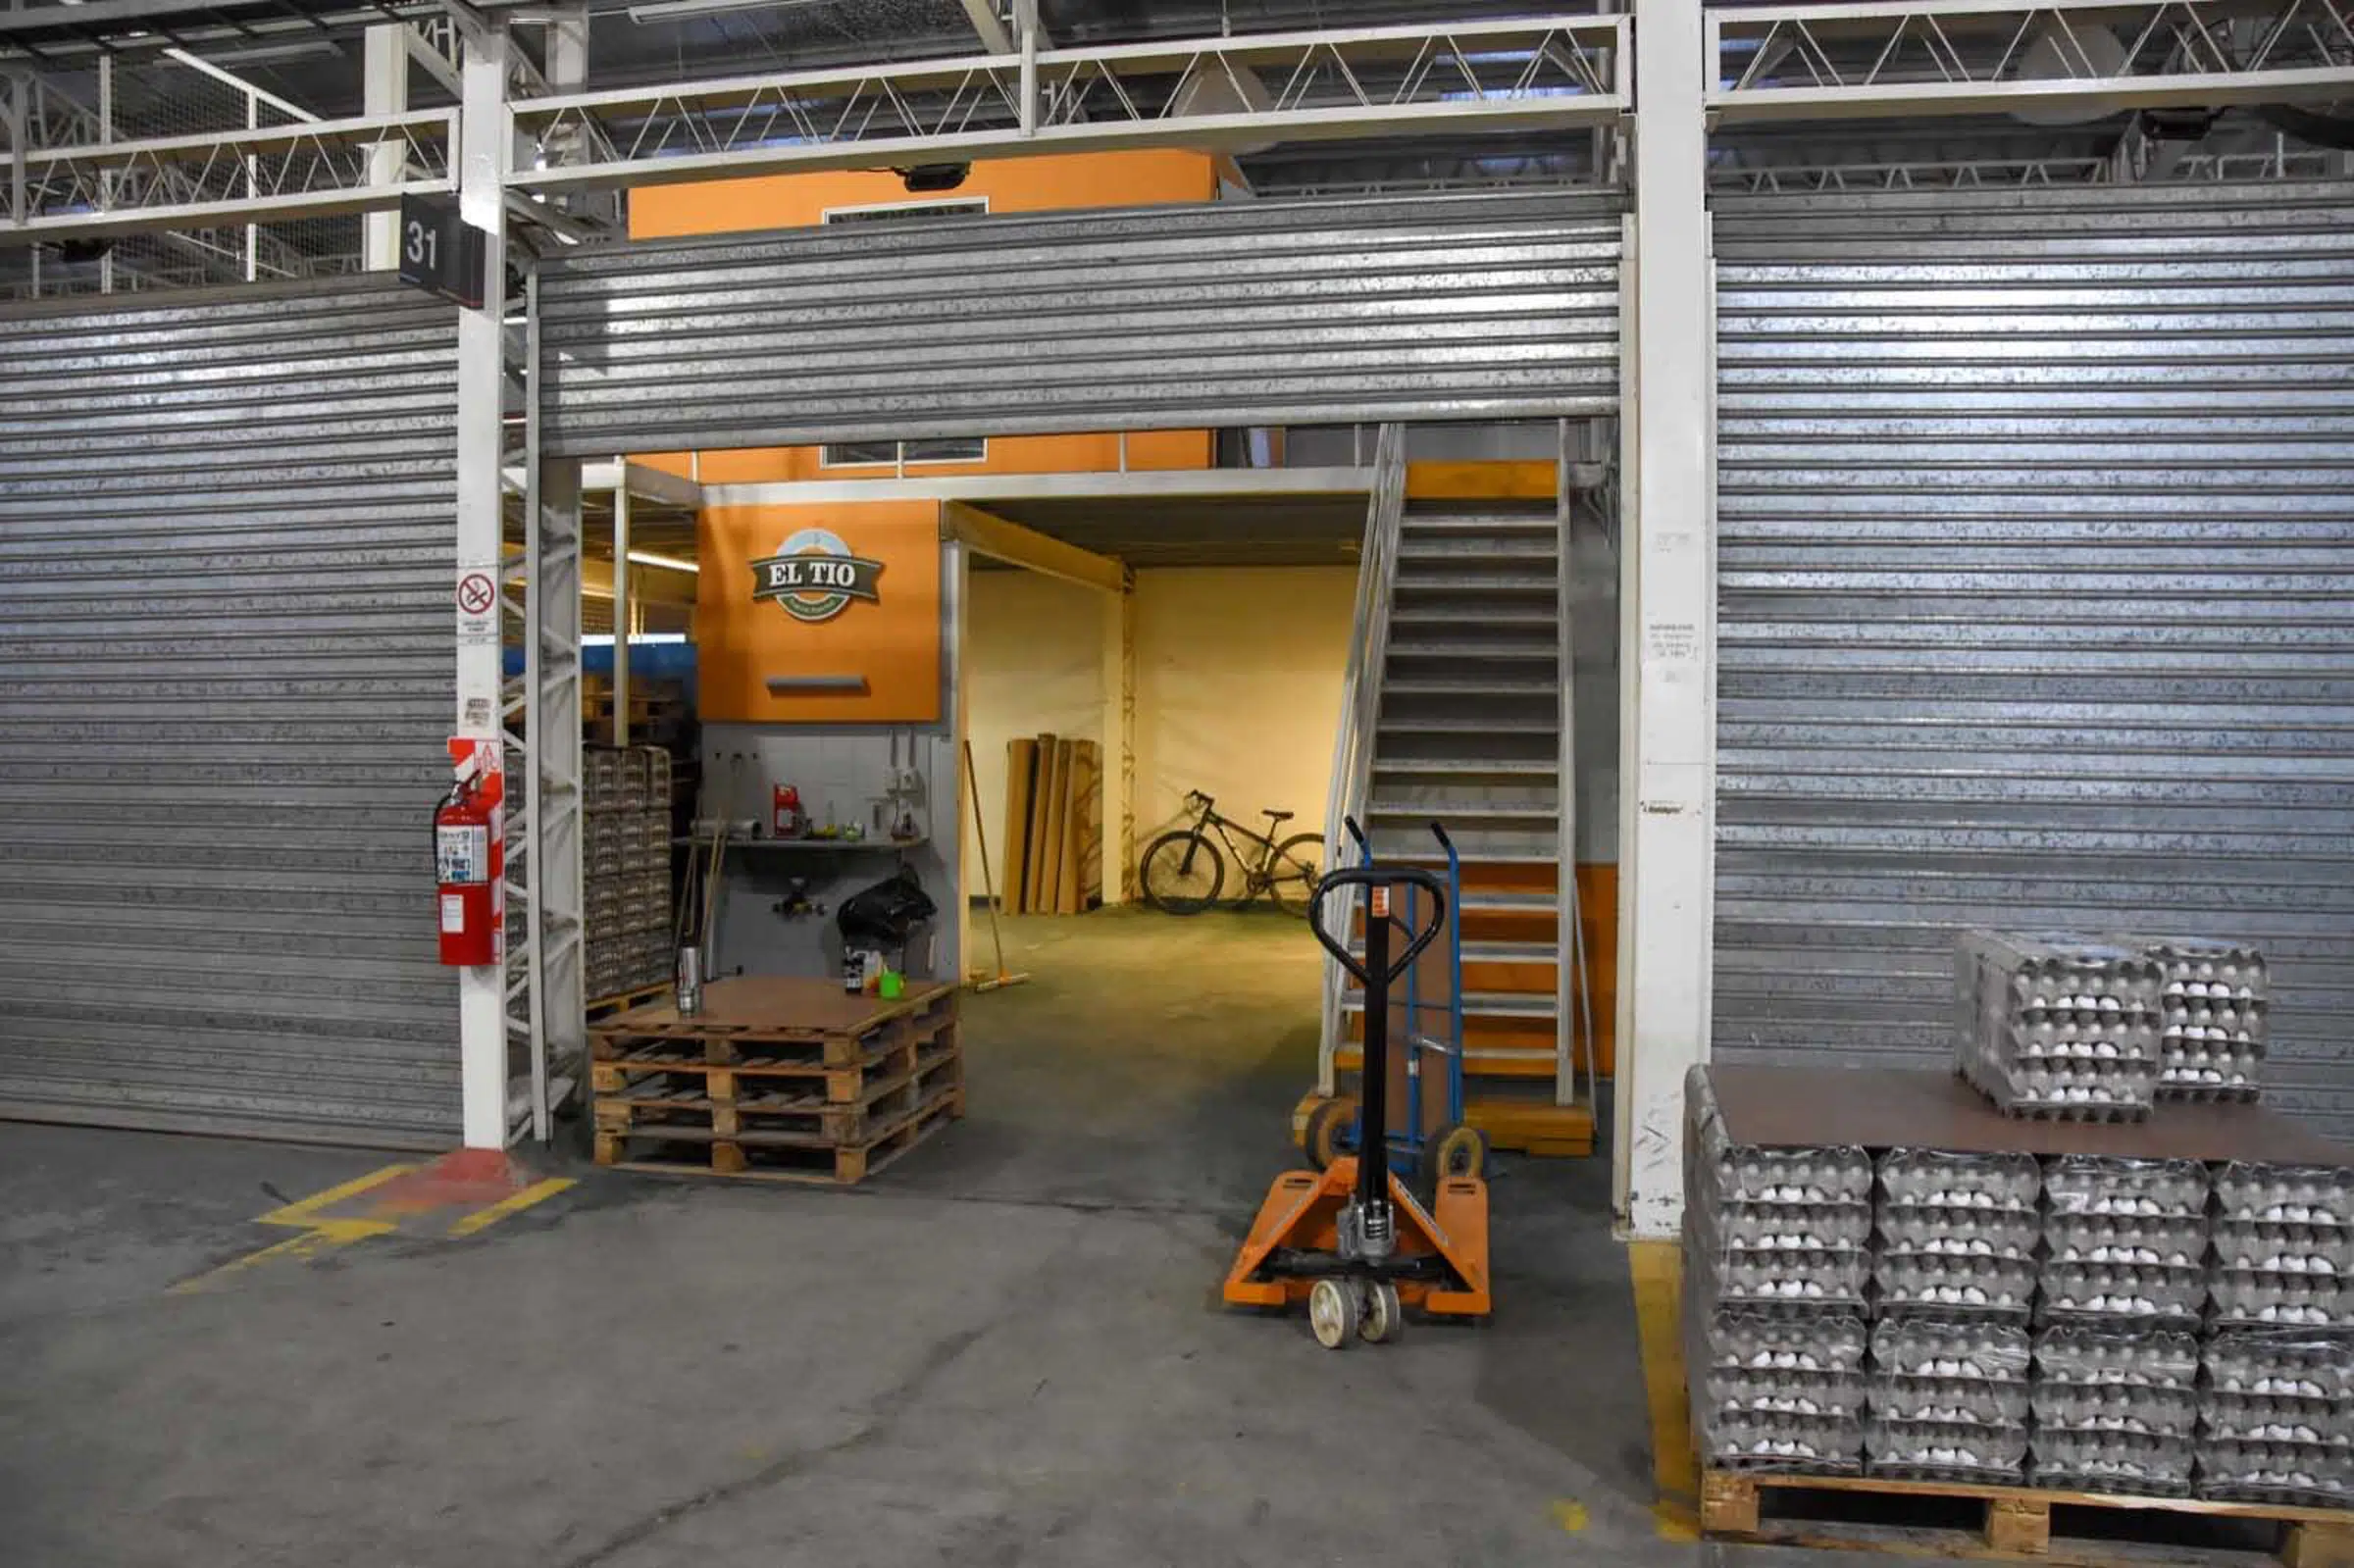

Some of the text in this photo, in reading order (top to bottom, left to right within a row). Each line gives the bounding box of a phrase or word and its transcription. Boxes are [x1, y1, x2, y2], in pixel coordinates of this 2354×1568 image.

[407, 221, 436, 270] 31
[769, 561, 855, 586] EL TIO
